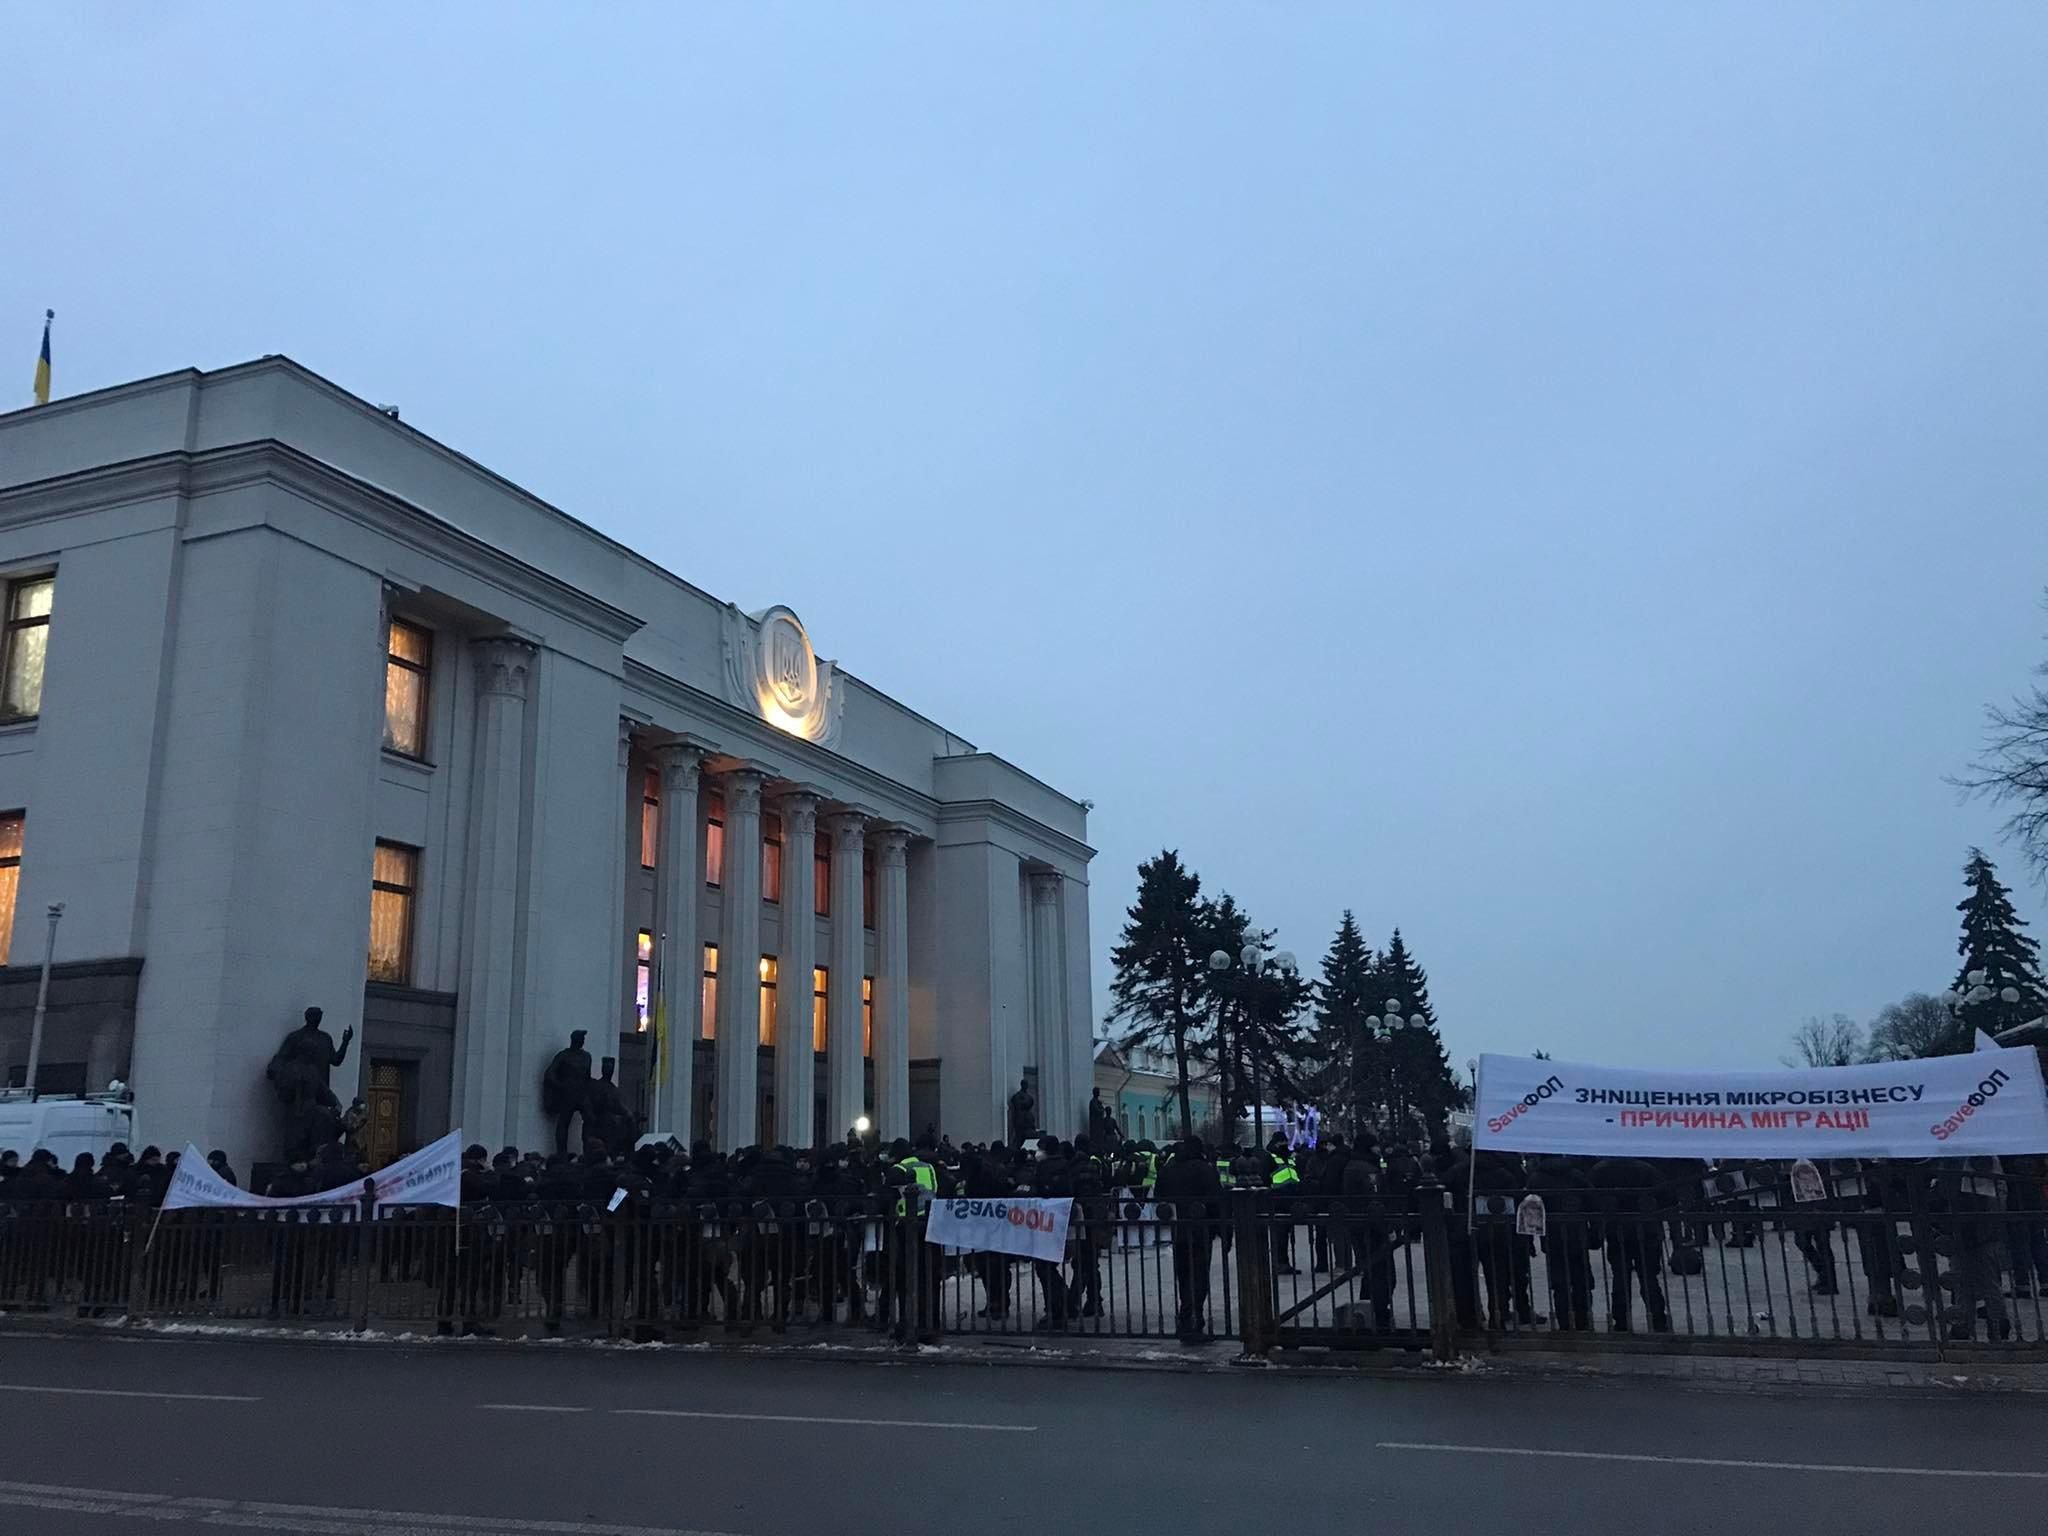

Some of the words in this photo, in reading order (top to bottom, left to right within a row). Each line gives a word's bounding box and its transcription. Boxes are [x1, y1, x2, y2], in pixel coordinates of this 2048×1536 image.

[1487, 1075, 1564, 1133] SaveФОП
[1726, 1084, 1924, 1105] МІКРОБІЗНЕСУ
[1929, 1068, 2010, 1140] SaveФОП
[1620, 1110, 1747, 1128] ПРИЧИНА
